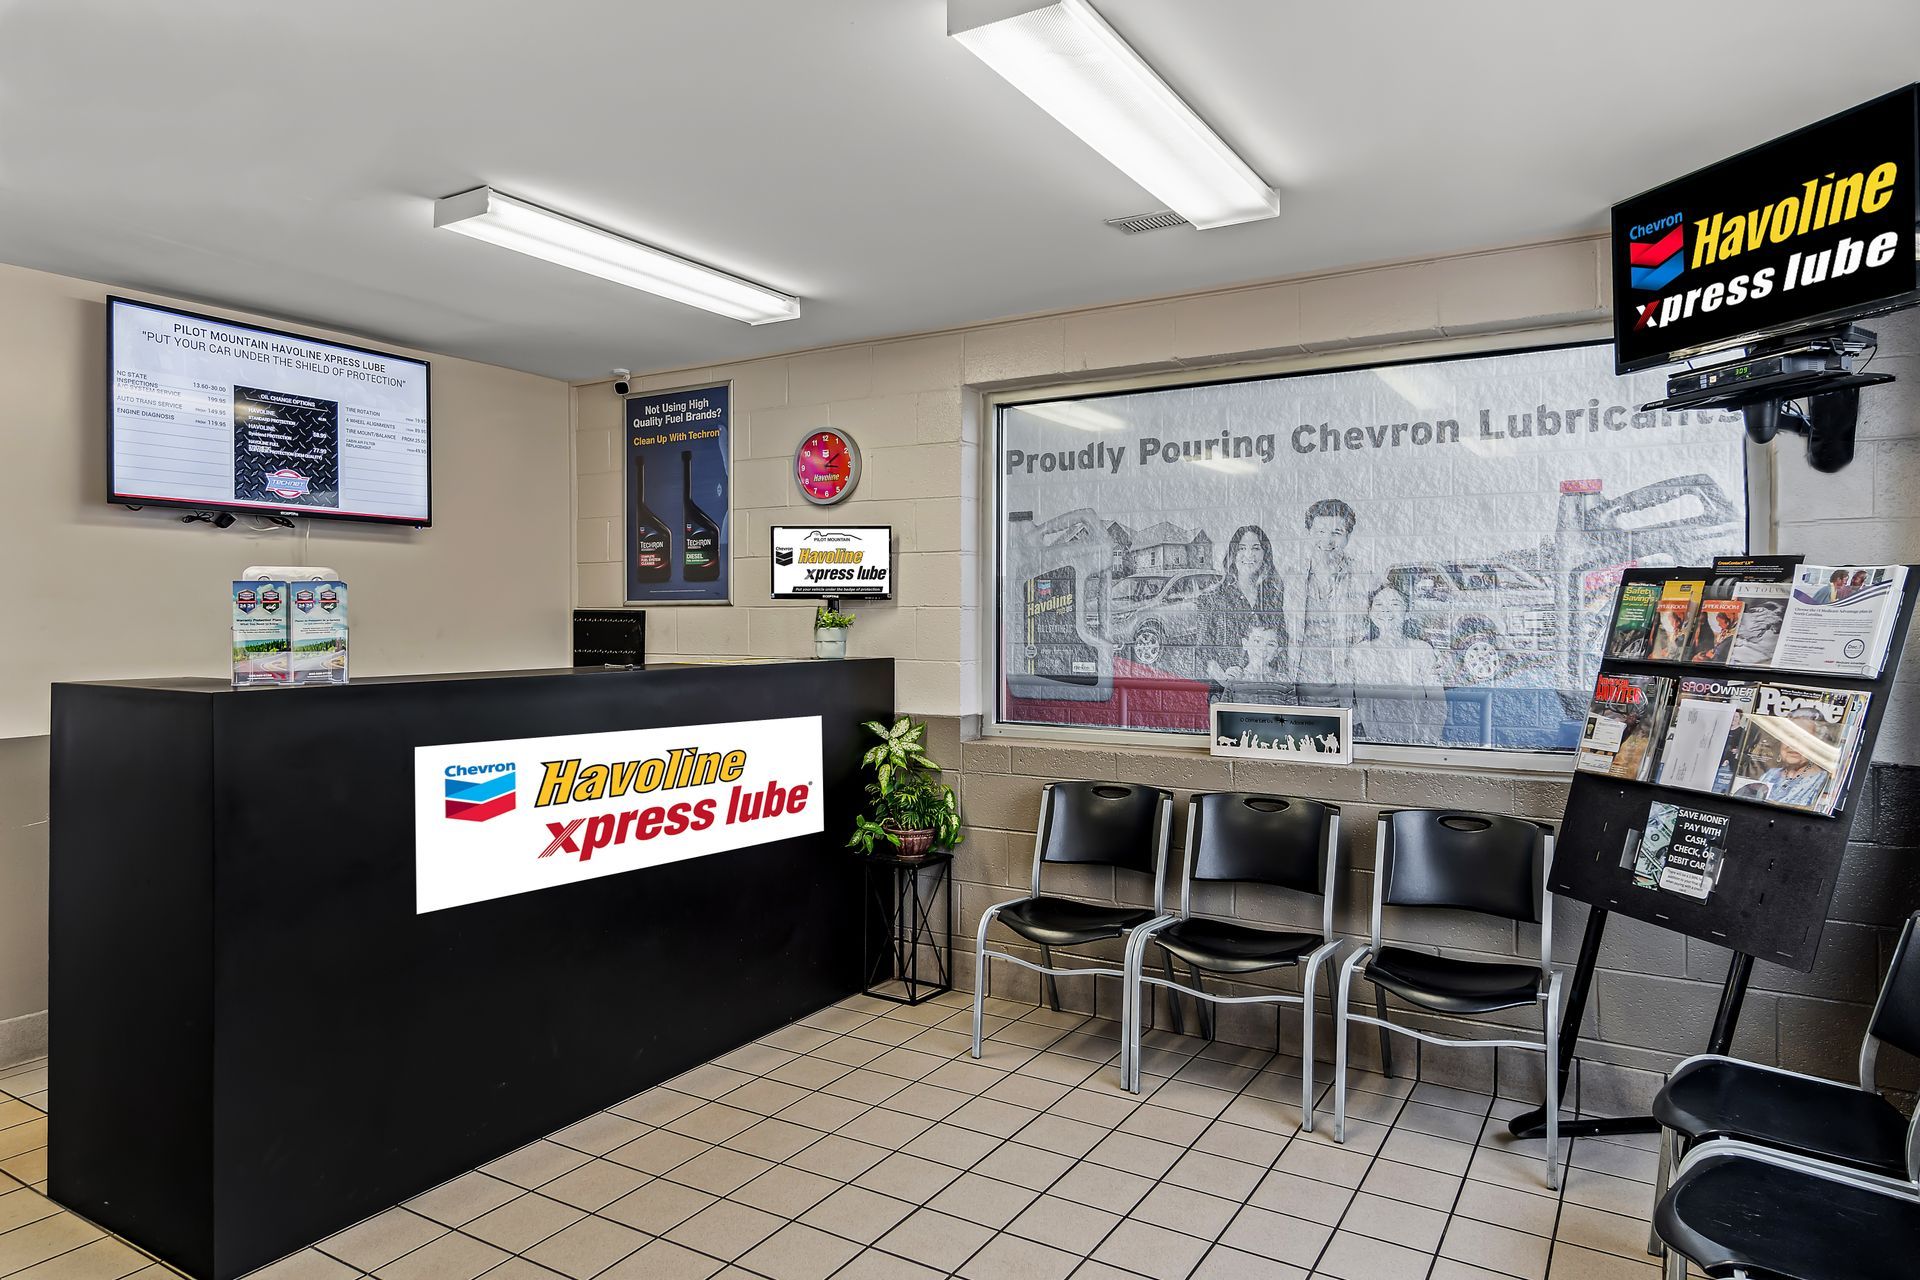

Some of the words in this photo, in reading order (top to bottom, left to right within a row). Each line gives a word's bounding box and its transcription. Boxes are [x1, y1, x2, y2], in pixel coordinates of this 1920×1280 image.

[1690, 162, 1898, 270] Havoline
[1630, 211, 1683, 240] Chevron
[1633, 266, 1775, 332] xpress
[1782, 231, 1898, 291] lube
[174, 324, 207, 338] PILOT
[210, 330, 269, 350] MOUNTAIN
[271, 342, 322, 361] HAVOLINE
[324, 353, 360, 368] XPRESS
[362, 361, 386, 373] LUBE
[142, 330, 171, 344] "PUT
[174, 337, 206, 352] YOUR
[208, 343, 231, 356] CAR
[234, 348, 270, 364] UNDER
[272, 355, 293, 368] THE
[295, 360, 330, 374] SHIELD
[332, 367, 345, 377] OF
[346, 370, 406, 388] PROTECTION"
[116, 377, 158, 388] INSPECTIONS
[127, 371, 148, 380] STATE
[156, 388, 182, 397] SERVICE
[136, 398, 157, 406] TRANS
[158, 400, 183, 410] SERVICE
[292, 398, 316, 408] OPTIONS
[644, 404, 660, 416] Not
[662, 402, 686, 412] Using
[689, 398, 709, 410] High
[116, 408, 140, 416] ENGINE
[141, 410, 175, 420] DIAGNOSIS
[357, 408, 380, 416] ROTATION
[633, 416, 663, 428] Quality
[666, 412, 684, 424] Fuel
[686, 408, 722, 422] Brands?
[634, 436, 656, 446] Clean
[656, 434, 668, 444] Up
[669, 432, 686, 442] With
[1006, 441, 1126, 476] Proudly
[1139, 429, 1276, 464] Pouring
[1291, 418, 1460, 455] Chevron
[814, 474, 840, 482] Havoline
[798, 548, 864, 564] Havoline
[804, 568, 855, 583] xpress
[856, 566, 886, 580] lube
[1622, 594, 1656, 604] Savings
[1624, 587, 1654, 598] Safety
[1028, 594, 1072, 617] Havoline
[444, 761, 516, 777] Chevron
[534, 747, 747, 808] Havoline
[538, 799, 717, 862] xpress
[725, 780, 810, 825] lube
[1678, 809, 1698, 820] SAVE
[1699, 814, 1728, 826] MONEY
[1684, 822, 1700, 832] PAY
[1700, 826, 1722, 836] WITH
[1684, 834, 1708, 846] CASH,
[1668, 854, 1689, 866] DEBIT
[1674, 844, 1700, 858] CHECK,
[1702, 850, 1714, 860] OR
